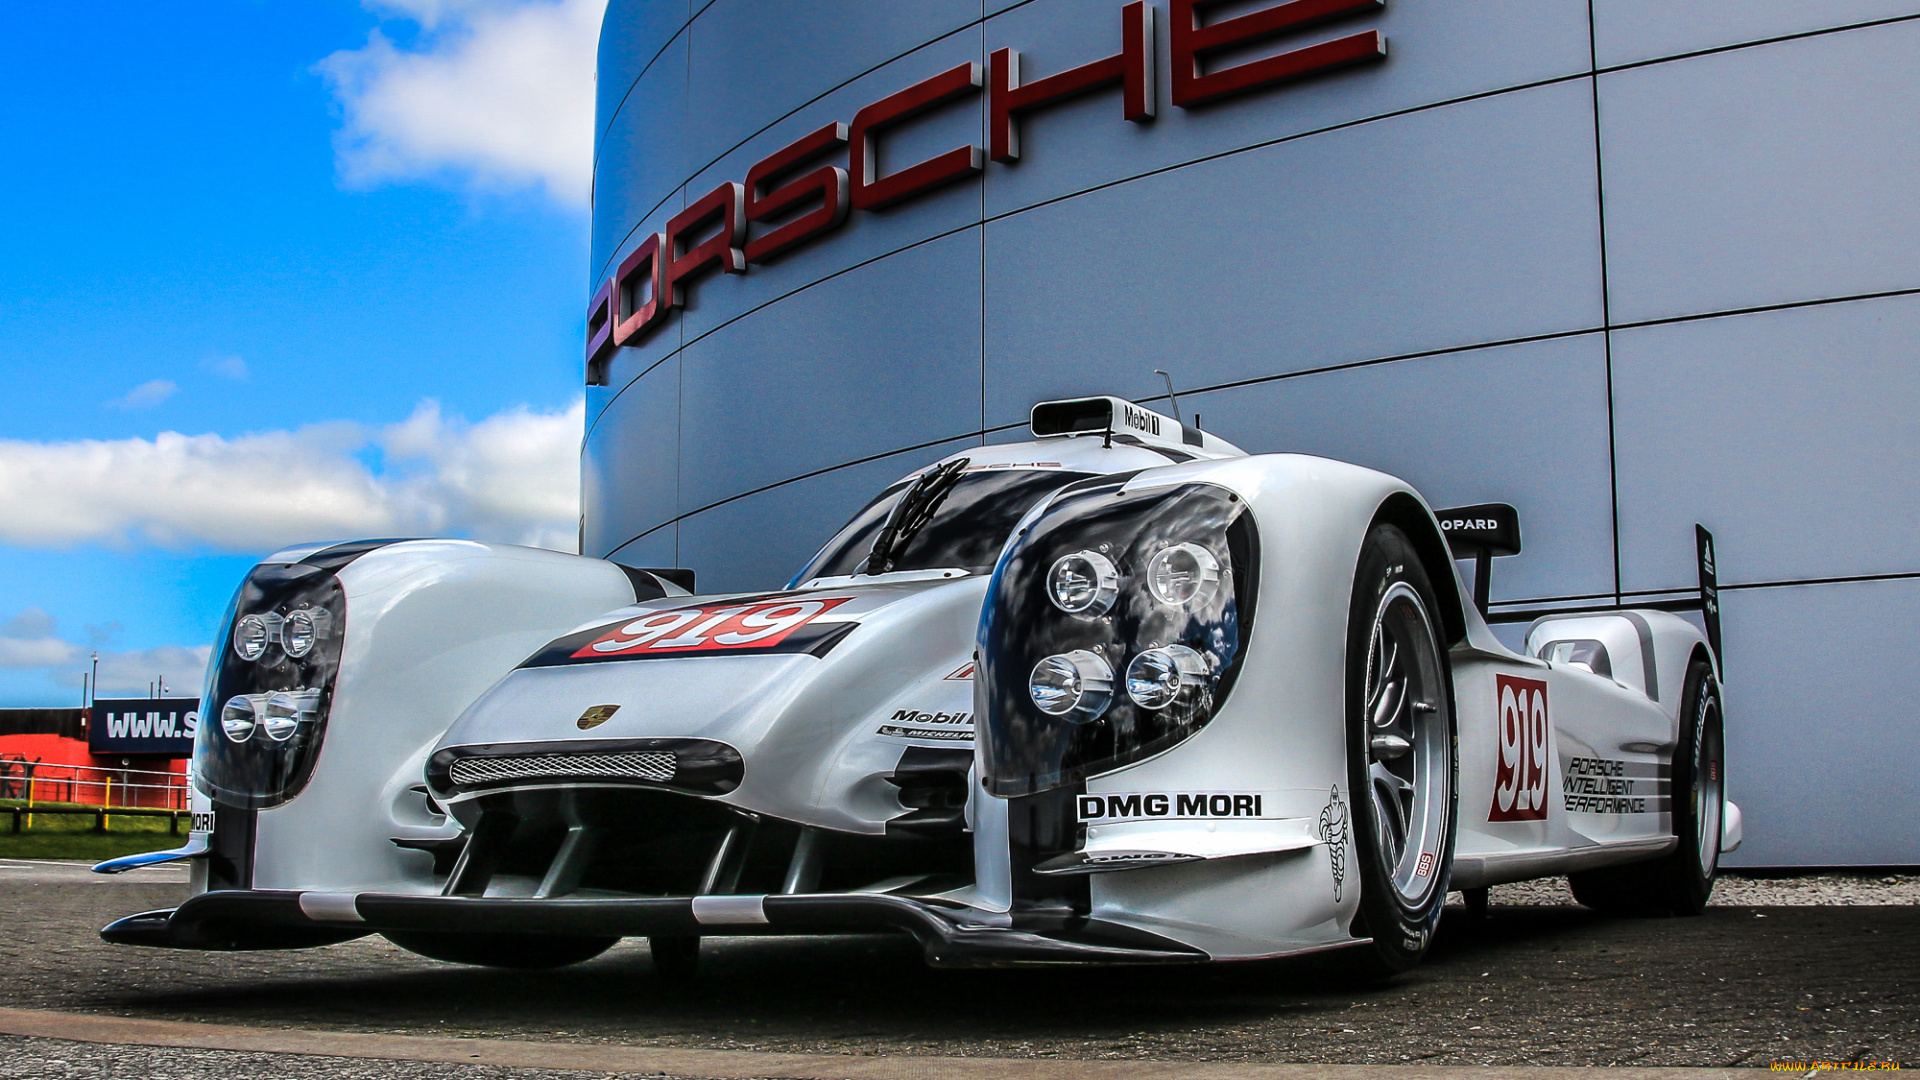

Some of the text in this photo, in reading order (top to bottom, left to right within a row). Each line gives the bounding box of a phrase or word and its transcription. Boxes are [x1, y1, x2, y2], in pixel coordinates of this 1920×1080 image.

[585, 0, 1387, 386] PORSCHE
[1124, 405, 1151, 434] Mobil
[1439, 519, 1498, 531] OPARD
[591, 600, 825, 653] 919
[106, 711, 199, 739] WWW.S
[890, 709, 968, 725] Mobil
[1497, 684, 1549, 812] 919
[1568, 757, 1625, 777] PORSCHE
[1563, 776, 1635, 796] INTELLIGENT
[1079, 794, 1262, 819] DMG MORI
[1416, 854, 1432, 878] BBS
